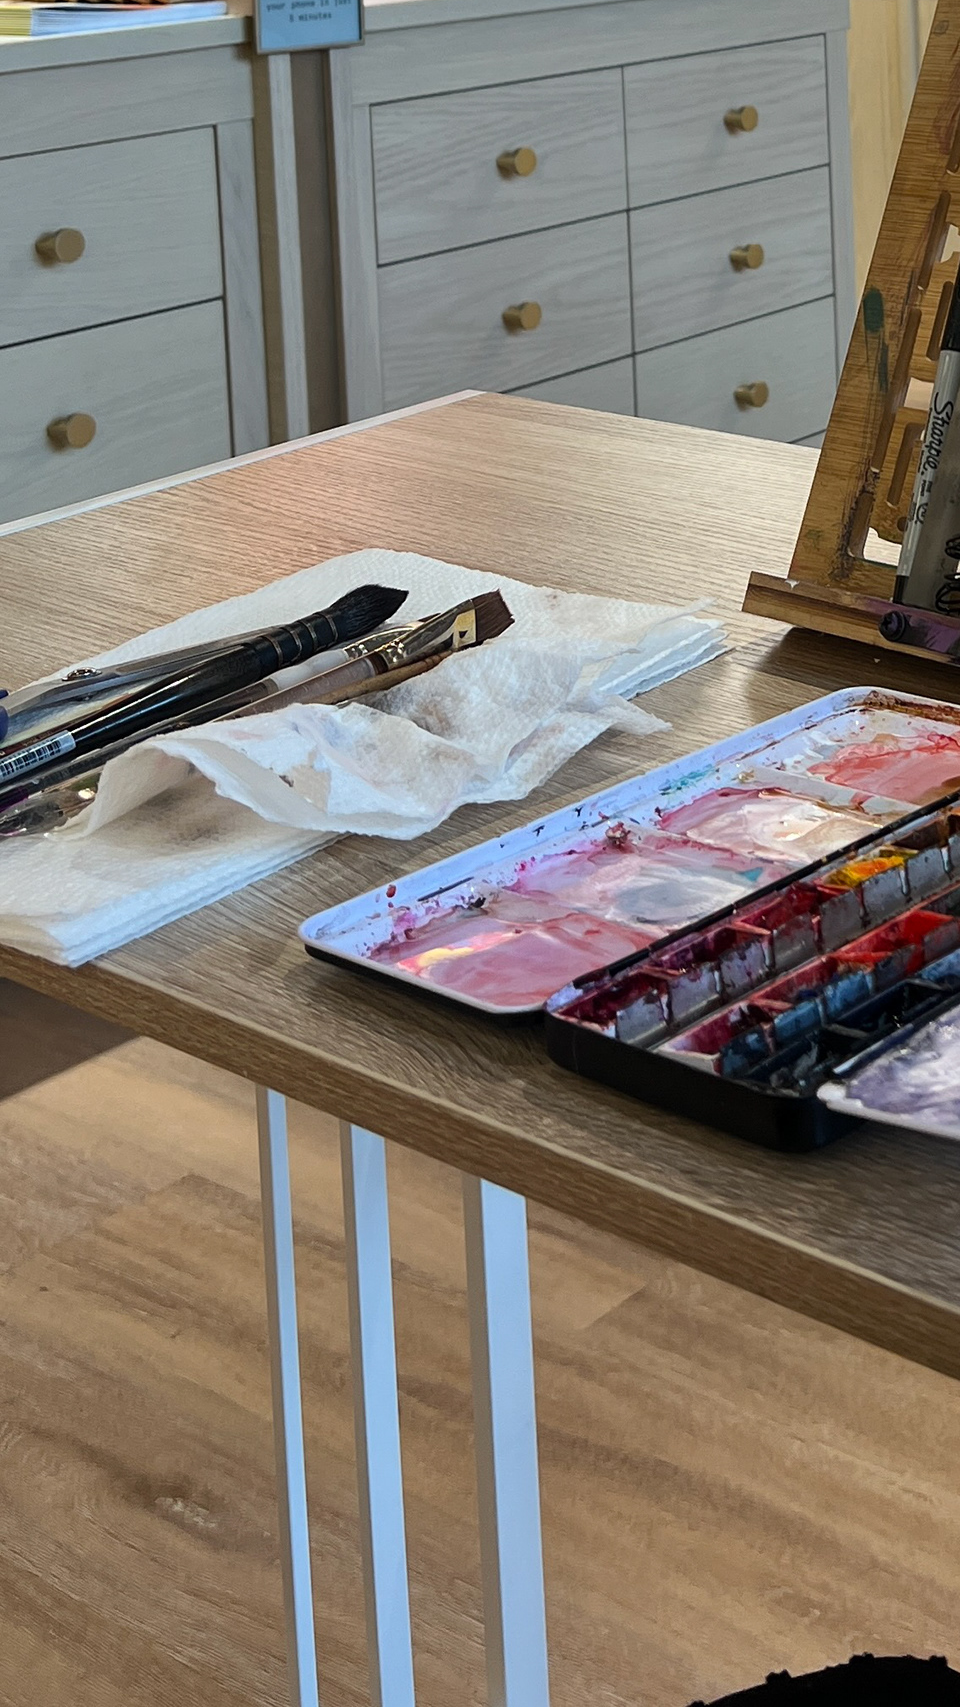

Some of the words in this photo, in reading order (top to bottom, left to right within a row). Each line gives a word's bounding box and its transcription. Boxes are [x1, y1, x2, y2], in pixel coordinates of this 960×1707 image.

[266, 2, 285, 12] your
[291, 0, 315, 10] phone
[298, 12, 332, 22] minutes
